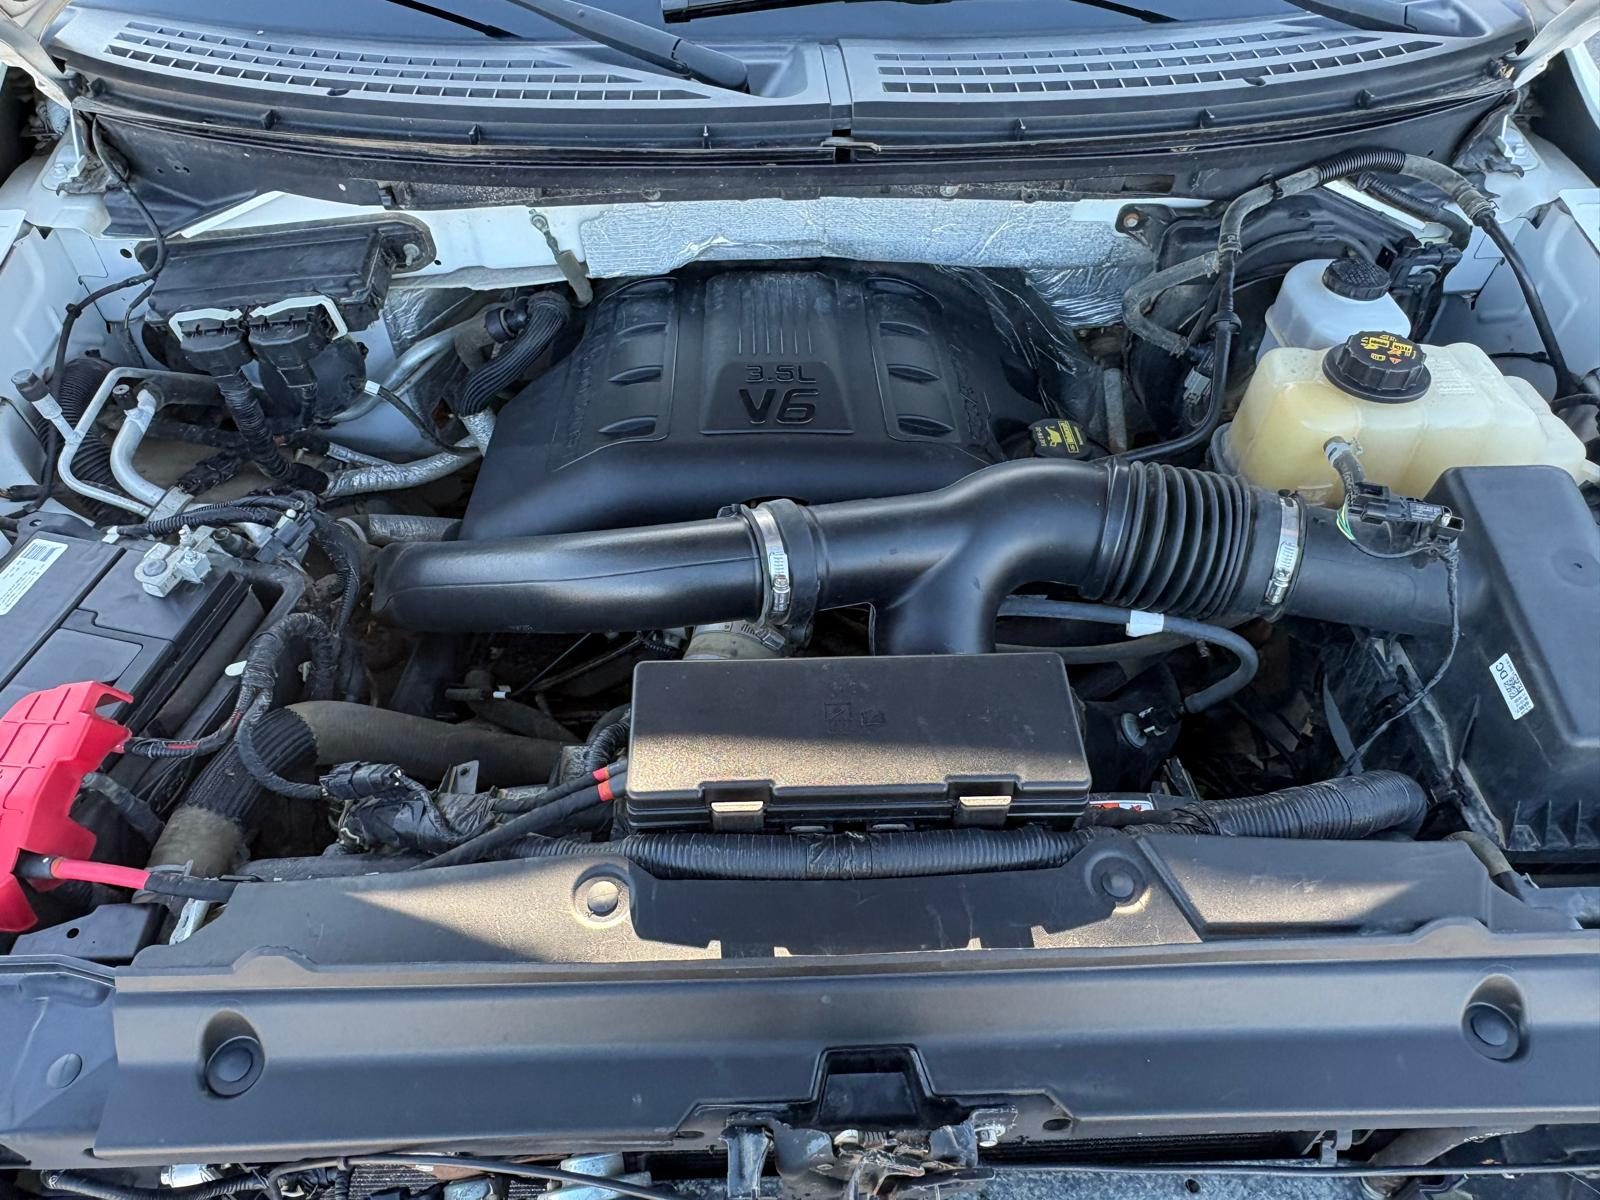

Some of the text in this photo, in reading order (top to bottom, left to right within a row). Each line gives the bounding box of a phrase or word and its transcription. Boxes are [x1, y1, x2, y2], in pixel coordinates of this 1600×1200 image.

[745, 364, 817, 383] 3.5L
[738, 388, 819, 424] V6
[1495, 662, 1509, 680] DC
